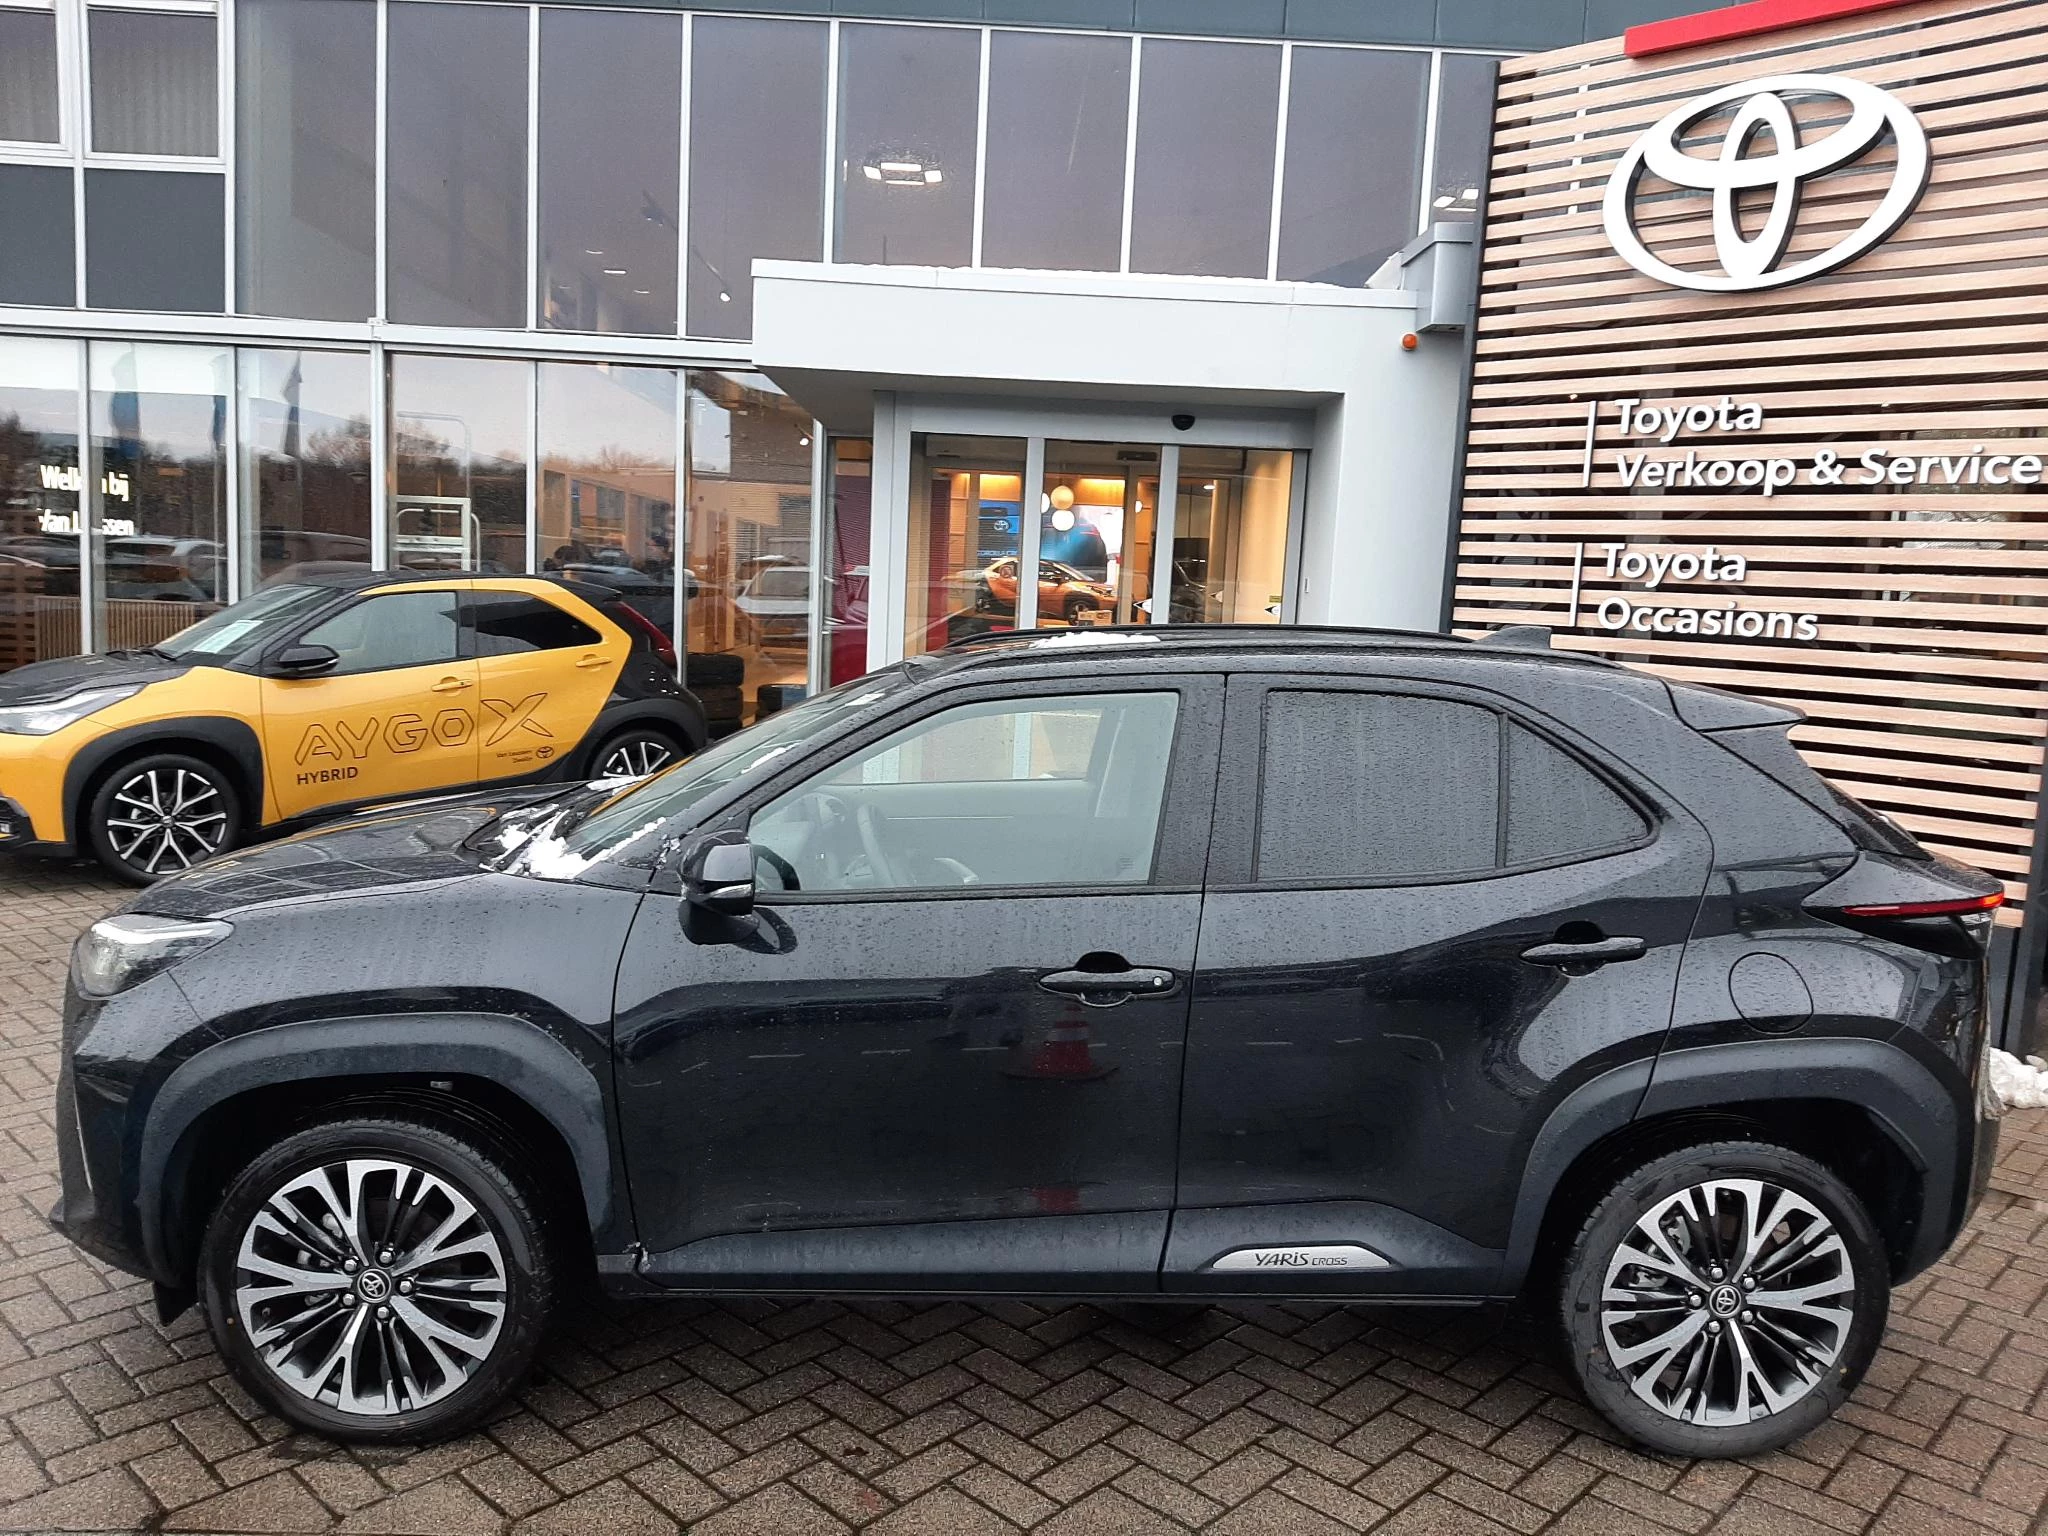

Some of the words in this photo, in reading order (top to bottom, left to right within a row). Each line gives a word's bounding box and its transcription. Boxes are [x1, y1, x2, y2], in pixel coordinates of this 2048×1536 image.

[1614, 397, 1763, 443] Toyota
[40, 464, 107, 494] Welk
[109, 471, 129, 502] bij
[1616, 451, 1796, 497] Verkoop
[1808, 448, 1845, 485] &
[1859, 445, 2043, 485] Service
[72, 510, 134, 536] Lssen
[1600, 542, 1746, 587] Toyota
[1597, 597, 1819, 642] Occasions
[294, 708, 475, 766] AYGO
[480, 692, 554, 747] X
[296, 766, 358, 785] HYBRID
[1312, 1257, 1348, 1266] CROSS
